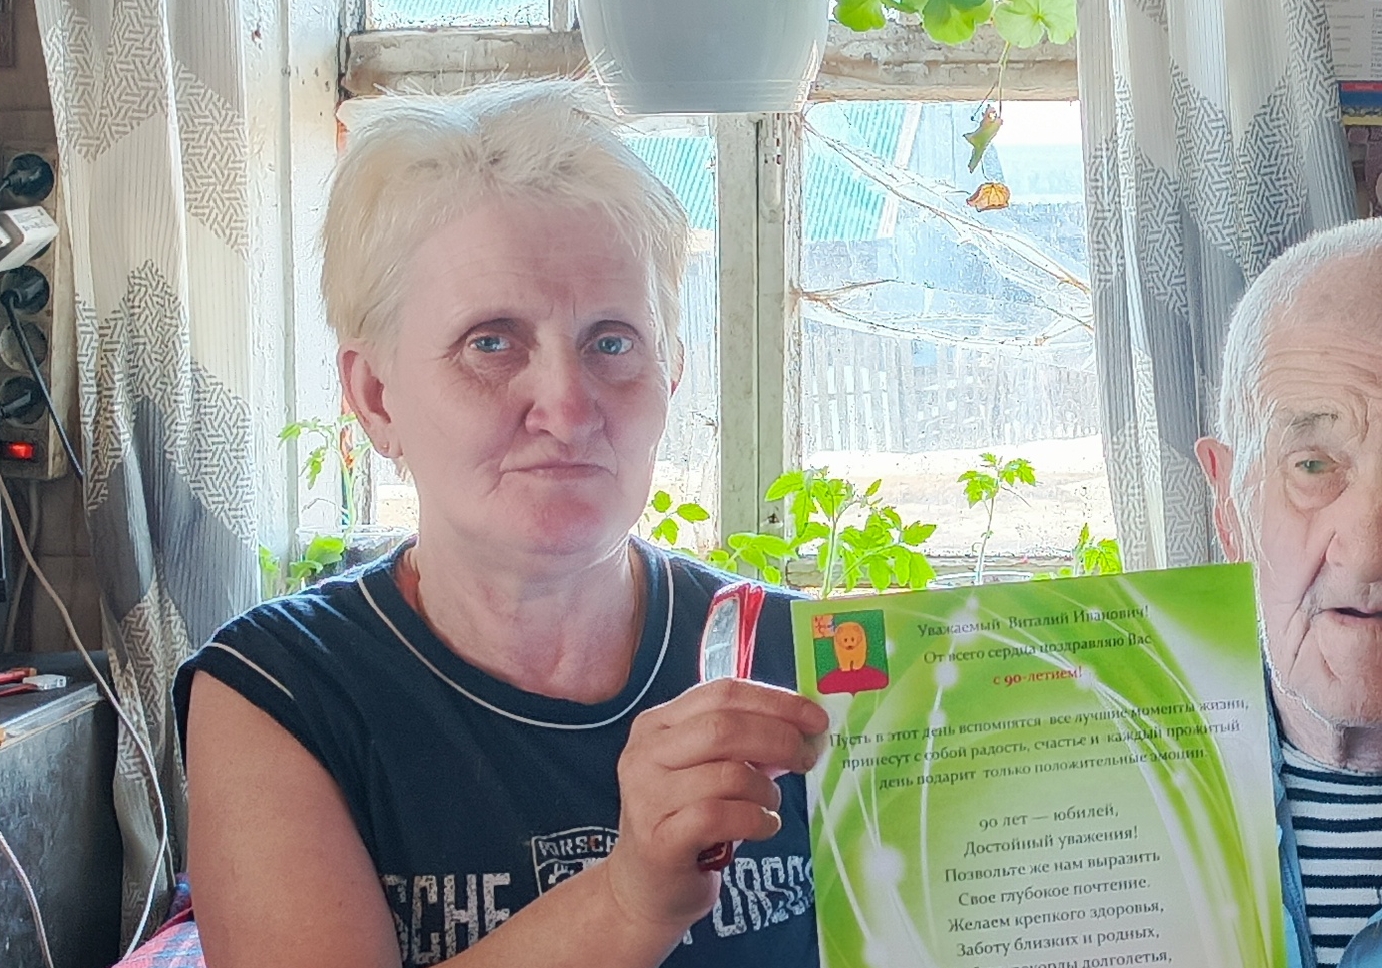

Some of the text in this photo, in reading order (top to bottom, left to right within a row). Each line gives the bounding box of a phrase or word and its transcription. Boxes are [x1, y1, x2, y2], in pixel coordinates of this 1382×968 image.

[917, 605, 1149, 637] Уважаемый Виталий Иванович!
[924, 632, 1151, 664] От всего сердца поздравляю Вас
[993, 666, 1082, 687] с 90-летием!
[830, 698, 1249, 748] Пусть в этот день вспомнятся все лучшие моменты жизни,
[842, 719, 1240, 771] принесут с собой радость, счастье и каждый прожитый
[880, 776, 913, 790] день
[917, 769, 976, 786] подарит
[983, 764, 1031, 778] только
[1035, 753, 1147, 773] положительные
[979, 818, 998, 831] 90
[1002, 814, 1028, 827] лет
[1053, 803, 1119, 822] юбилей,
[964, 825, 1138, 858] Достойный уважения!
[945, 851, 1160, 882] Позвольте же нам выразить
[958, 876, 1151, 907] Свое глубокое почтение.
[384, 872, 511, 965] SCHE
[948, 901, 1164, 933] Желаем крепкого здоровья,
[957, 926, 1160, 957] Заботу близких и родных,
